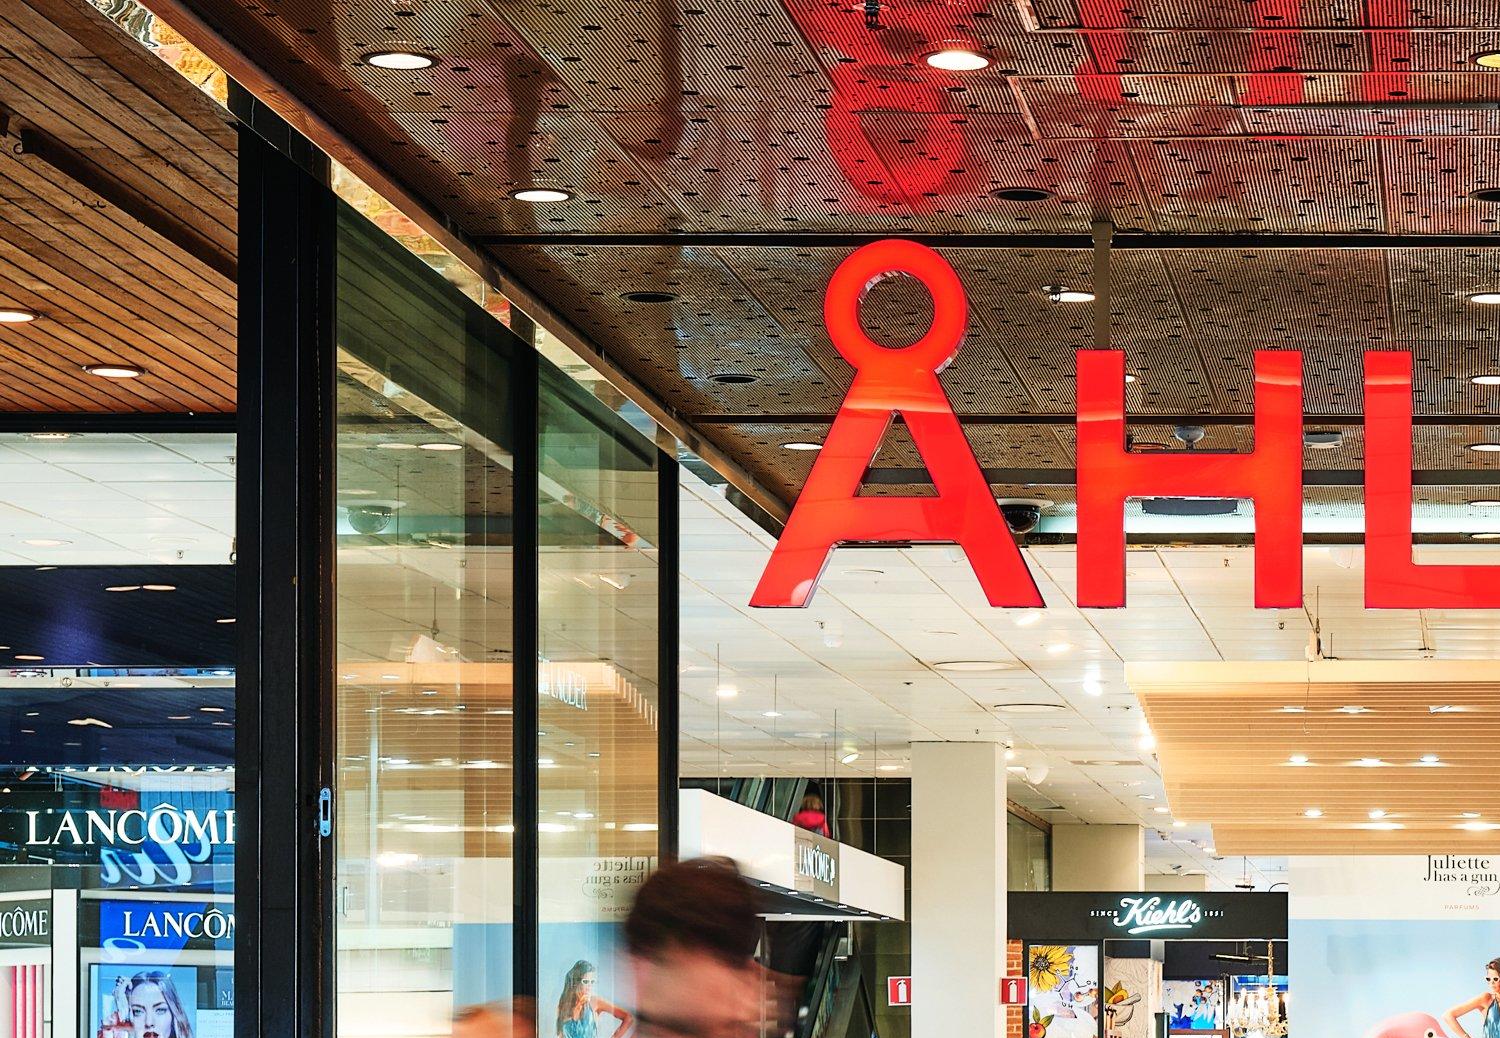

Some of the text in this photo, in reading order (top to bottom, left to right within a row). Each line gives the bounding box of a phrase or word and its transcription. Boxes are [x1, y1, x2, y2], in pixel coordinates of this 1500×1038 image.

[799, 845, 830, 883] LANCÔME
[1423, 855, 1490, 881] Juliette
[1434, 870, 1457, 882] has
[1460, 873, 1468, 882] a
[0, 907, 49, 937] CÔME
[1113, 896, 1201, 929] Kiehl's
